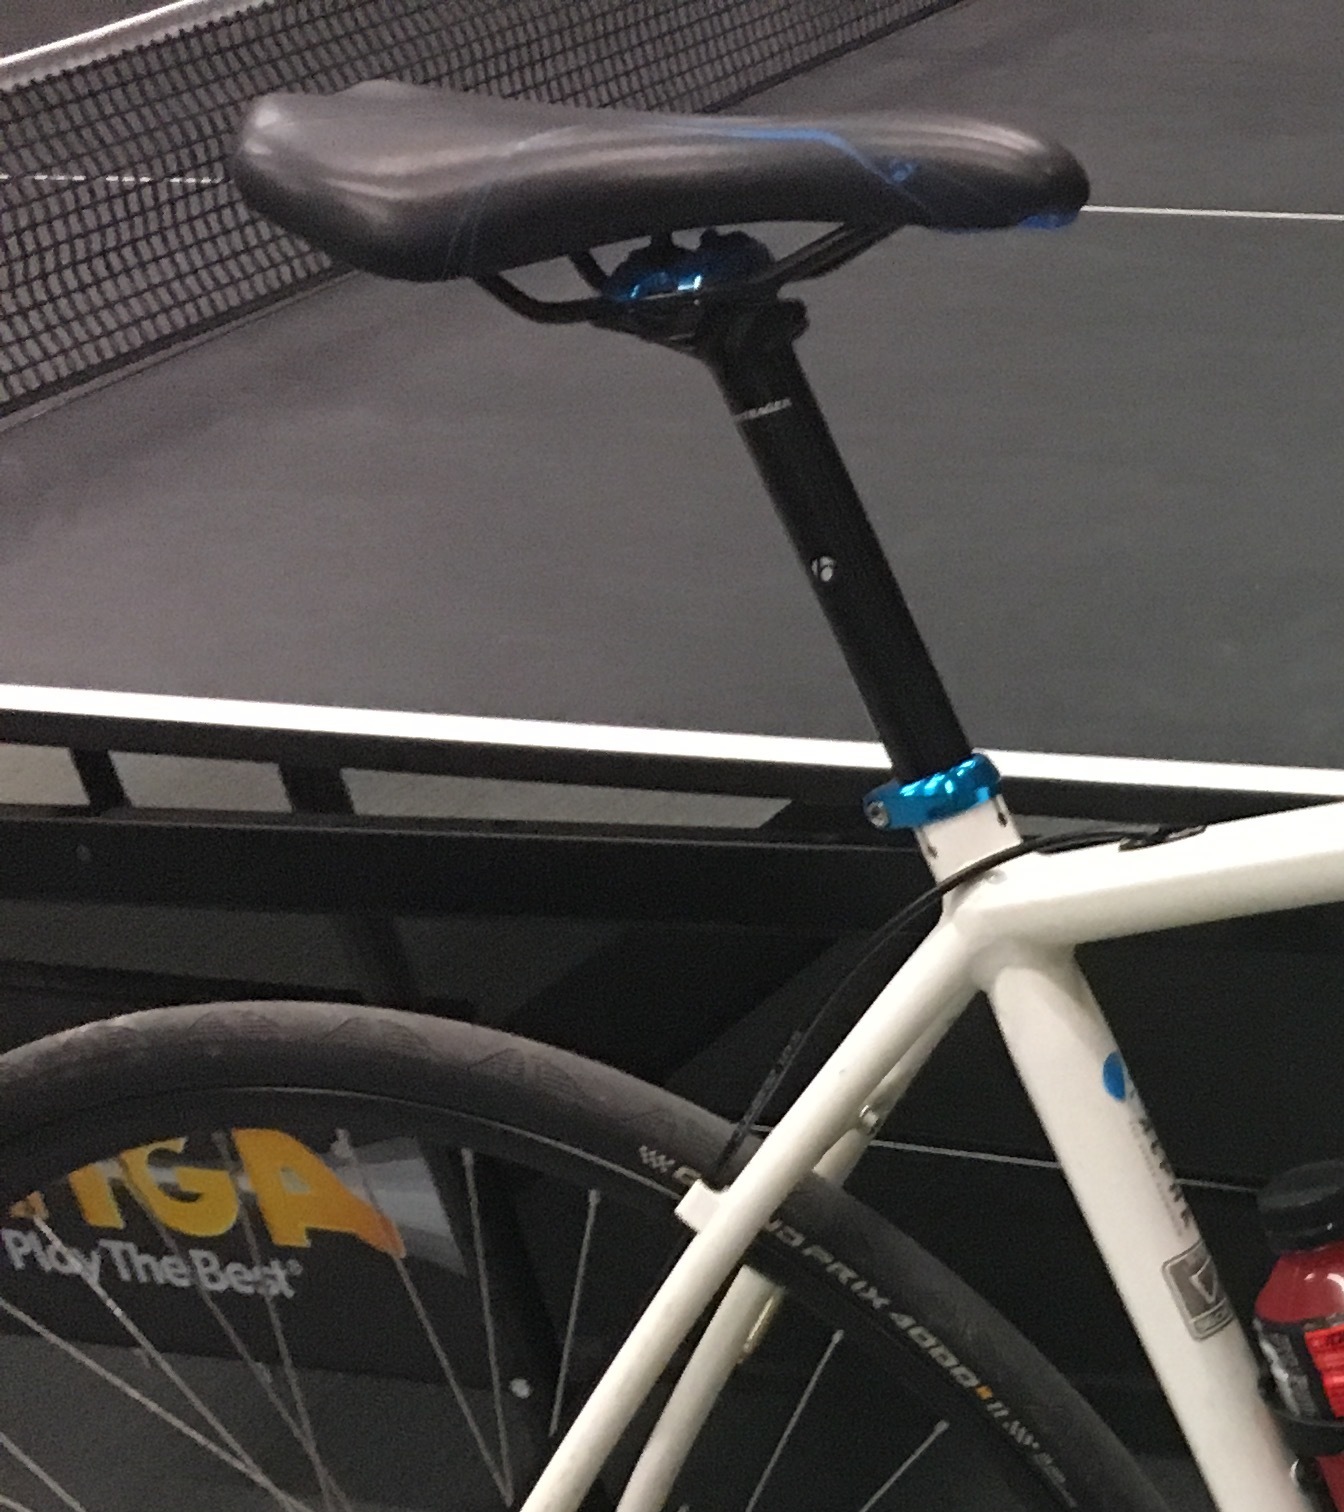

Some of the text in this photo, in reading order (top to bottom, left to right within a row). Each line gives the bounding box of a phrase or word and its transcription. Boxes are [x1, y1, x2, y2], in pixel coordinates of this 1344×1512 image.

[1, 1227, 102, 1284] Play
[98, 1237, 194, 1288] The
[803, 1244, 891, 1310] PRIX
